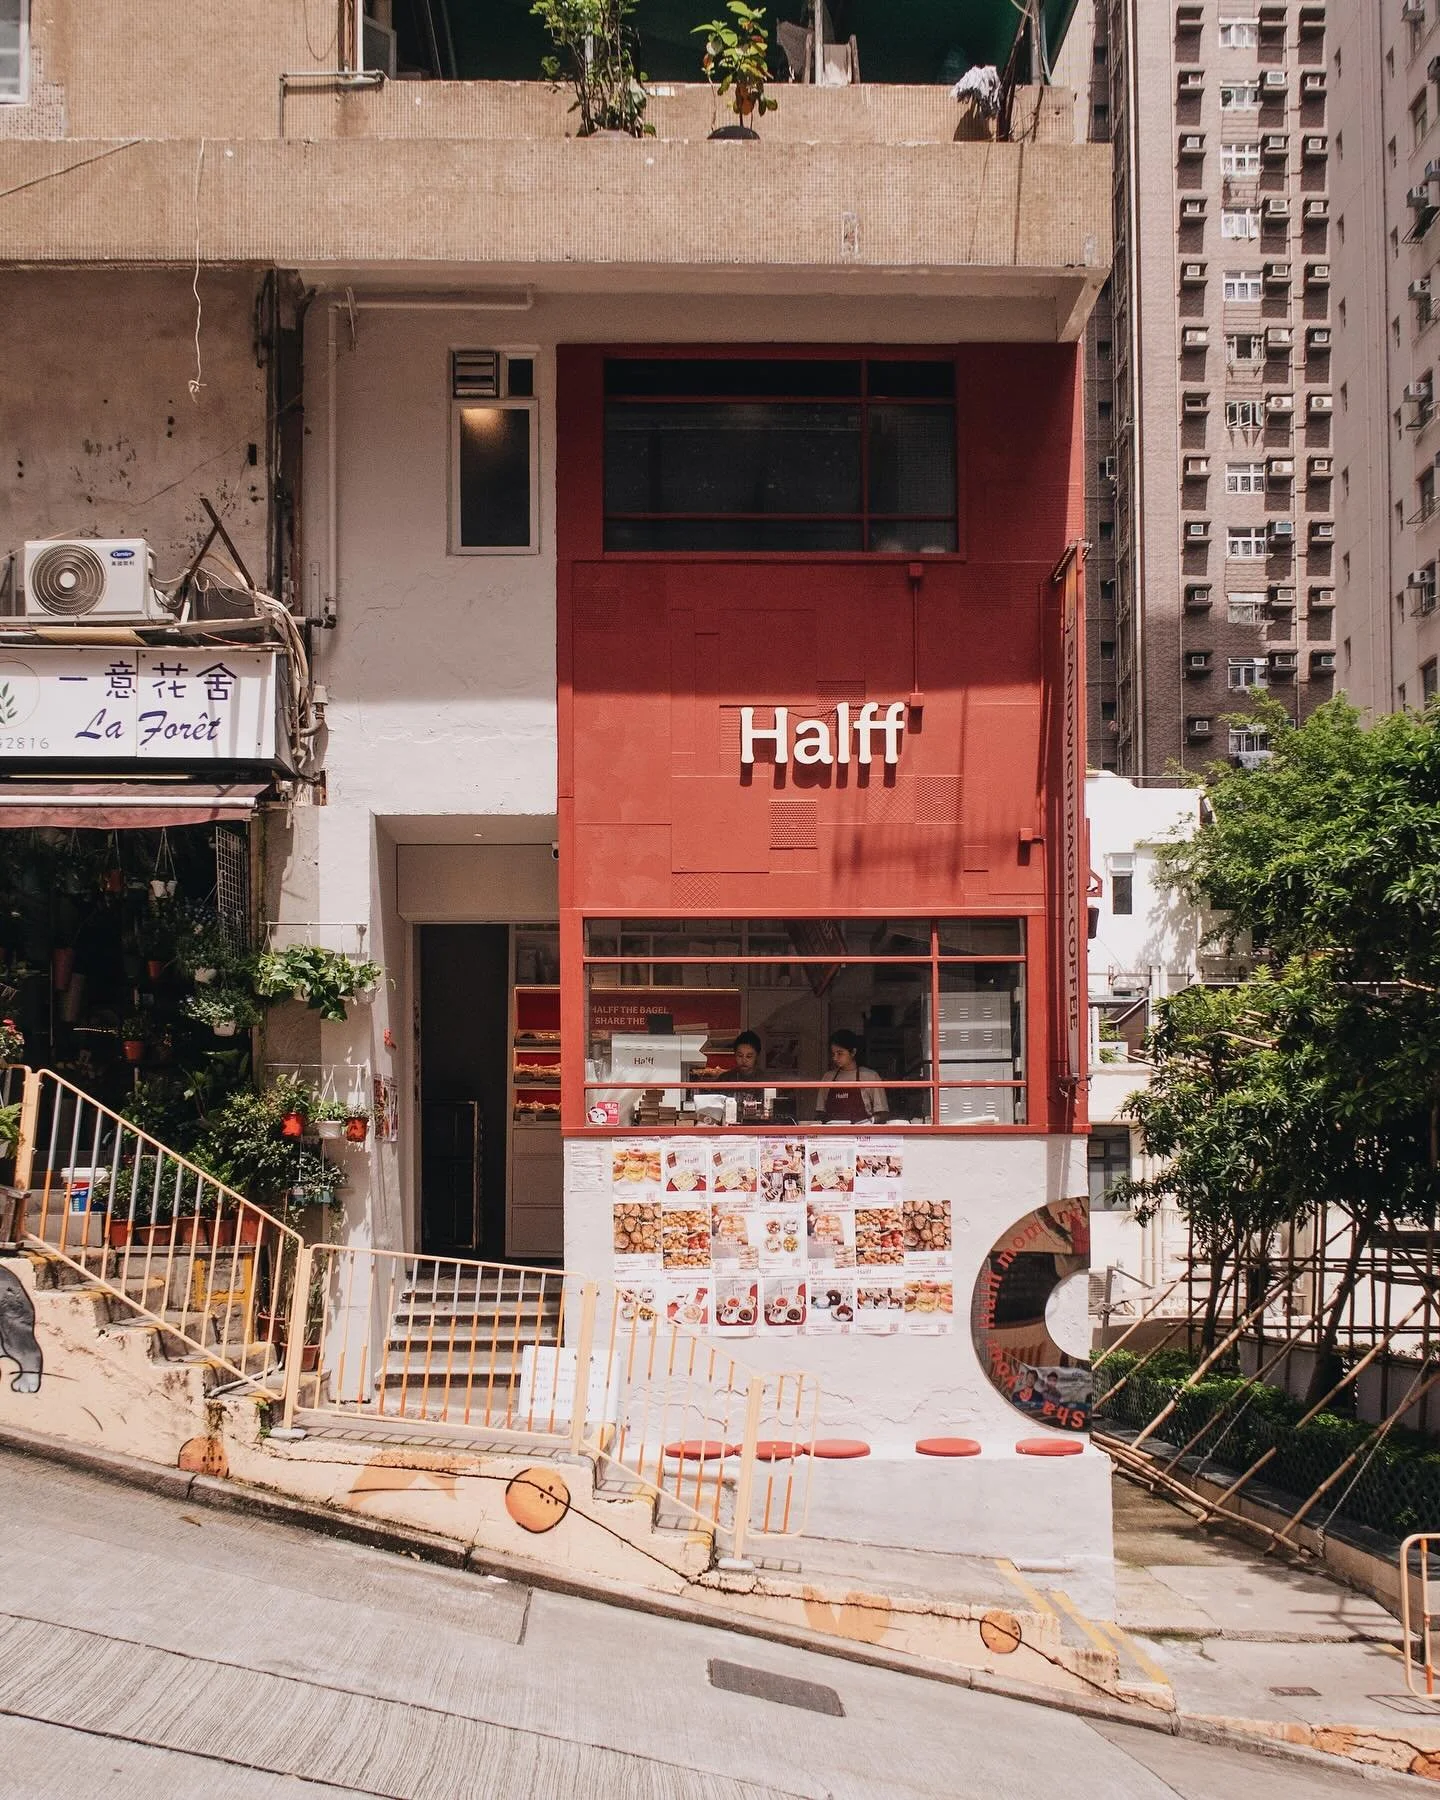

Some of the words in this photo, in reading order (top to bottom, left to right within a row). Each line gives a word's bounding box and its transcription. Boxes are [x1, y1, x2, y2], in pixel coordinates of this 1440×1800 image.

[59, 661, 237, 700] 一意花舍
[75, 708, 124, 739] La
[138, 711, 221, 745] Forêt
[741, 702, 905, 764] Halff
[0, 737, 49, 749] 2816
[595, 1017, 625, 1025] SHARE
[627, 1017, 645, 1025] THE
[621, 1006, 638, 1014] THE
